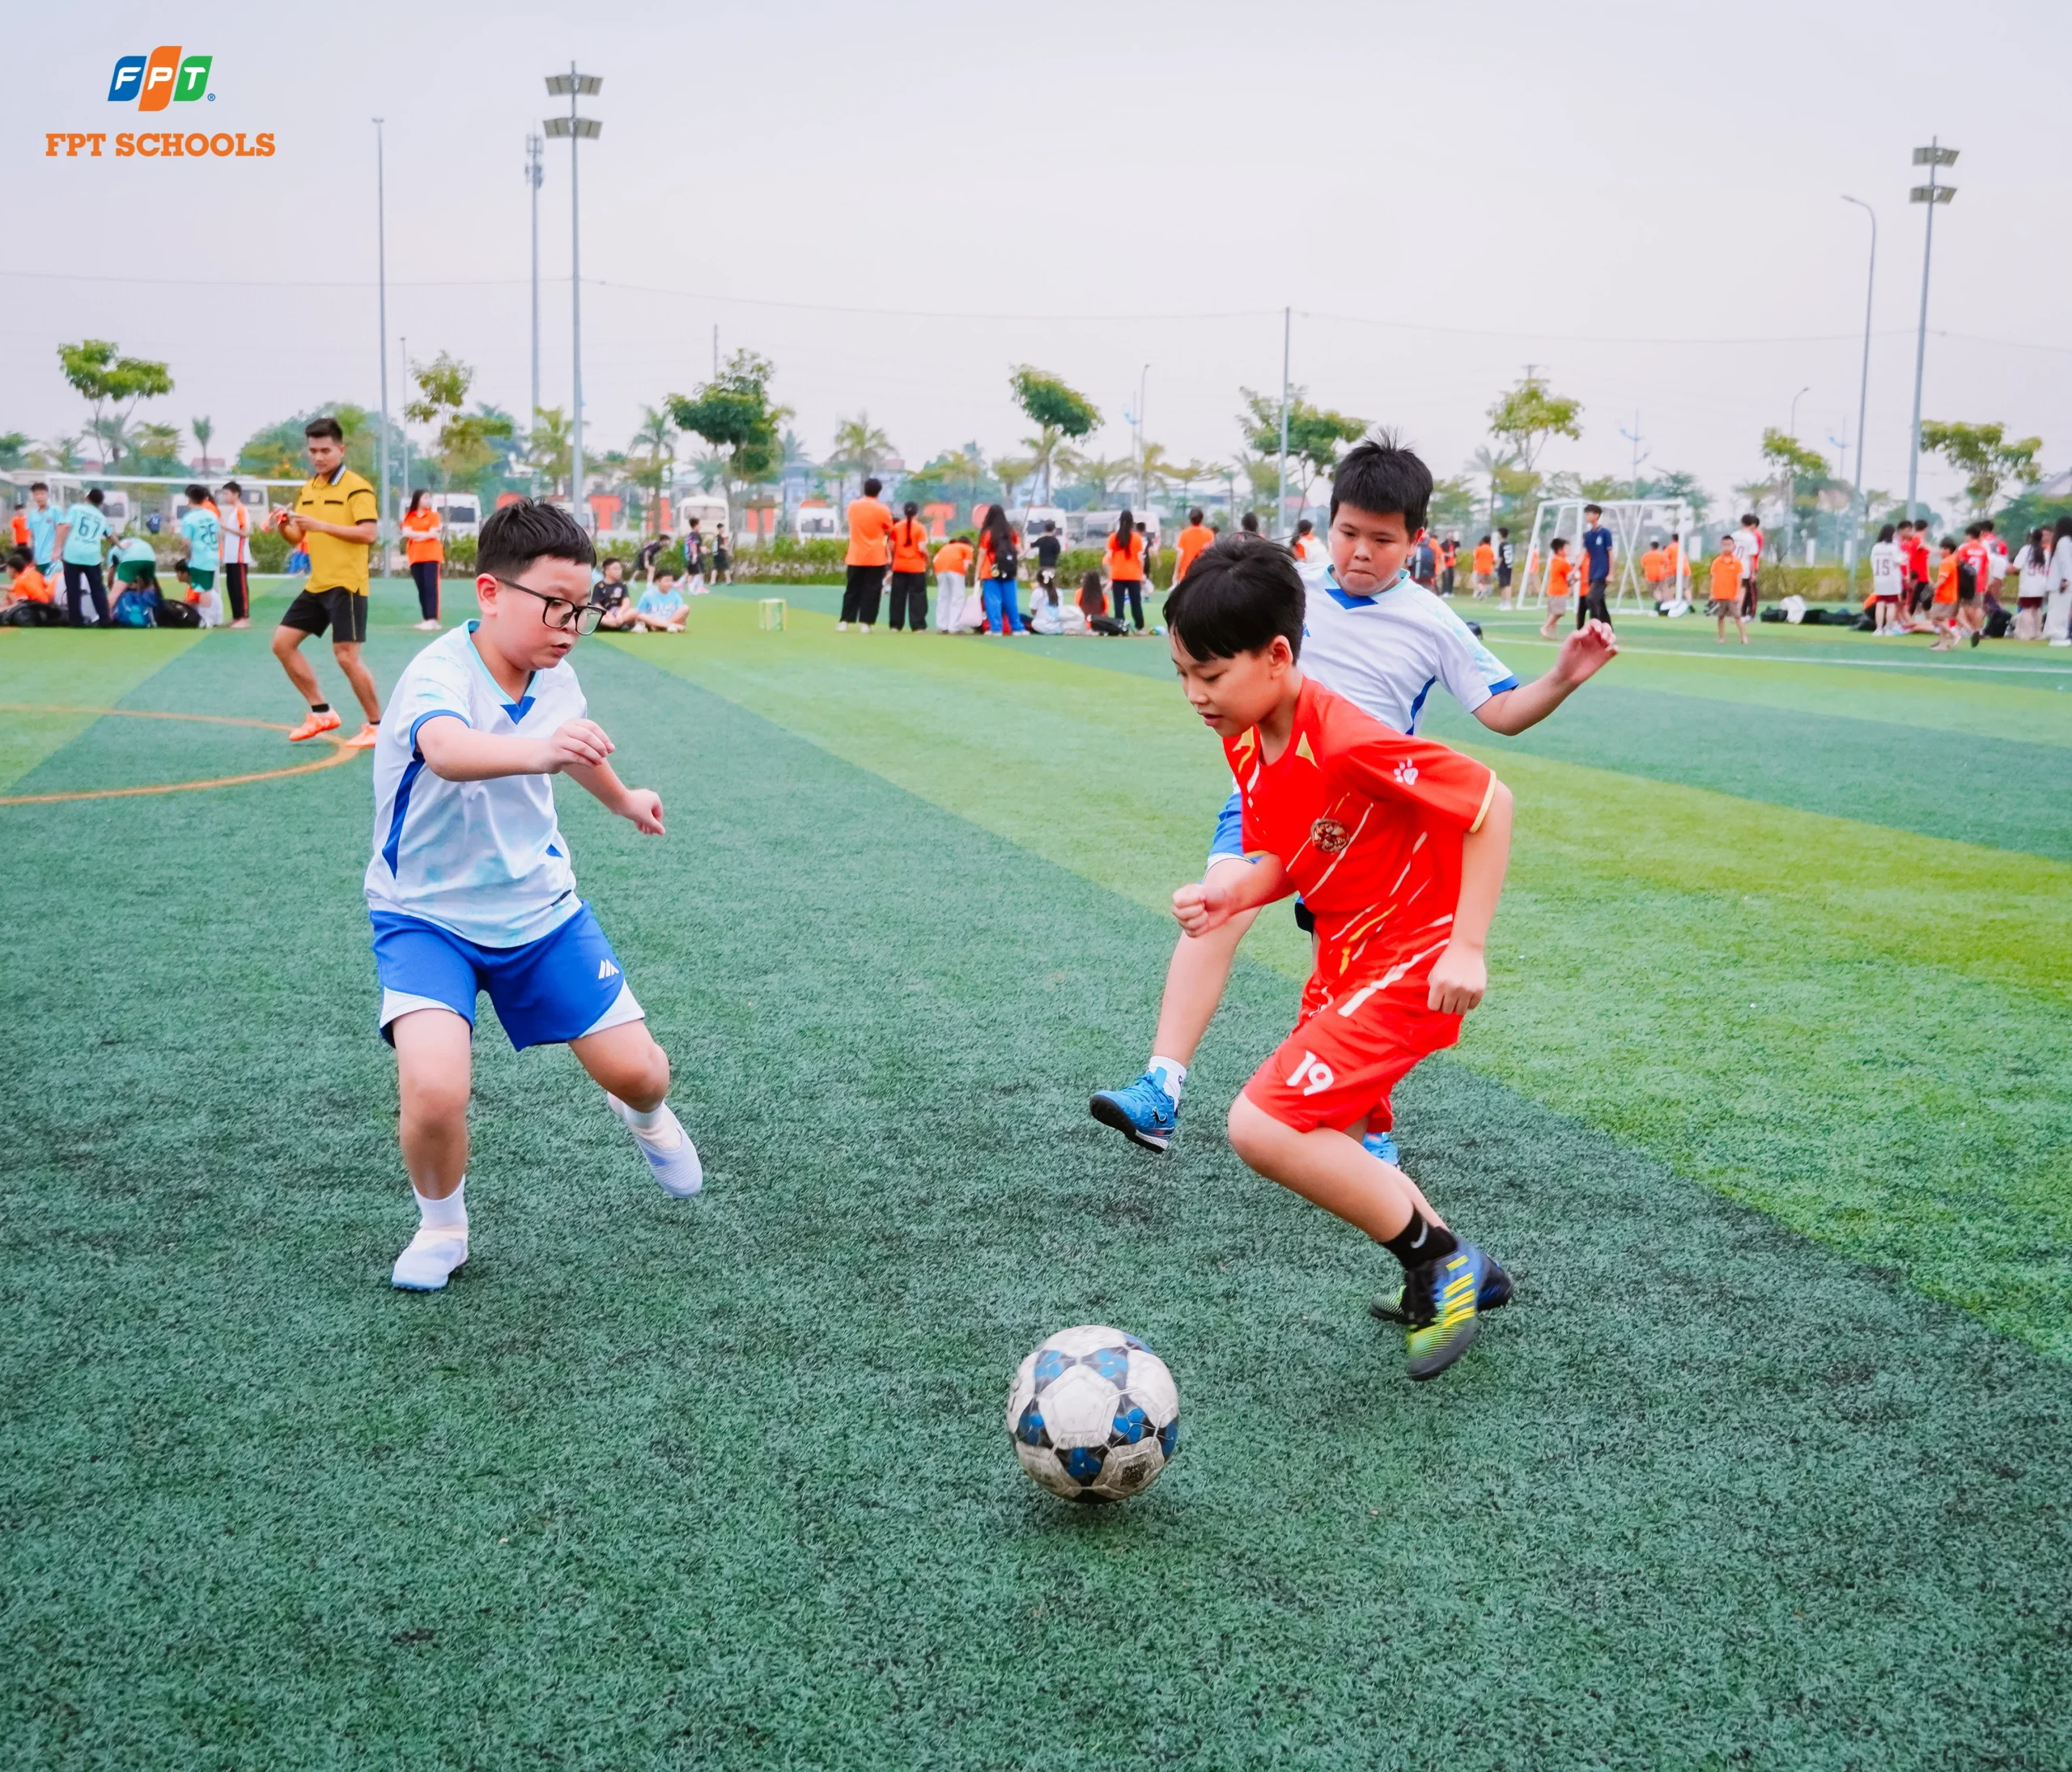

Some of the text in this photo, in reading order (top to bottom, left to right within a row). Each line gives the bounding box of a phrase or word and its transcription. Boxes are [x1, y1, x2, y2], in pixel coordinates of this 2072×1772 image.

[79, 516, 100, 538] 67
[1875, 559, 1890, 576] 15
[1287, 1051, 1335, 1097] 19
